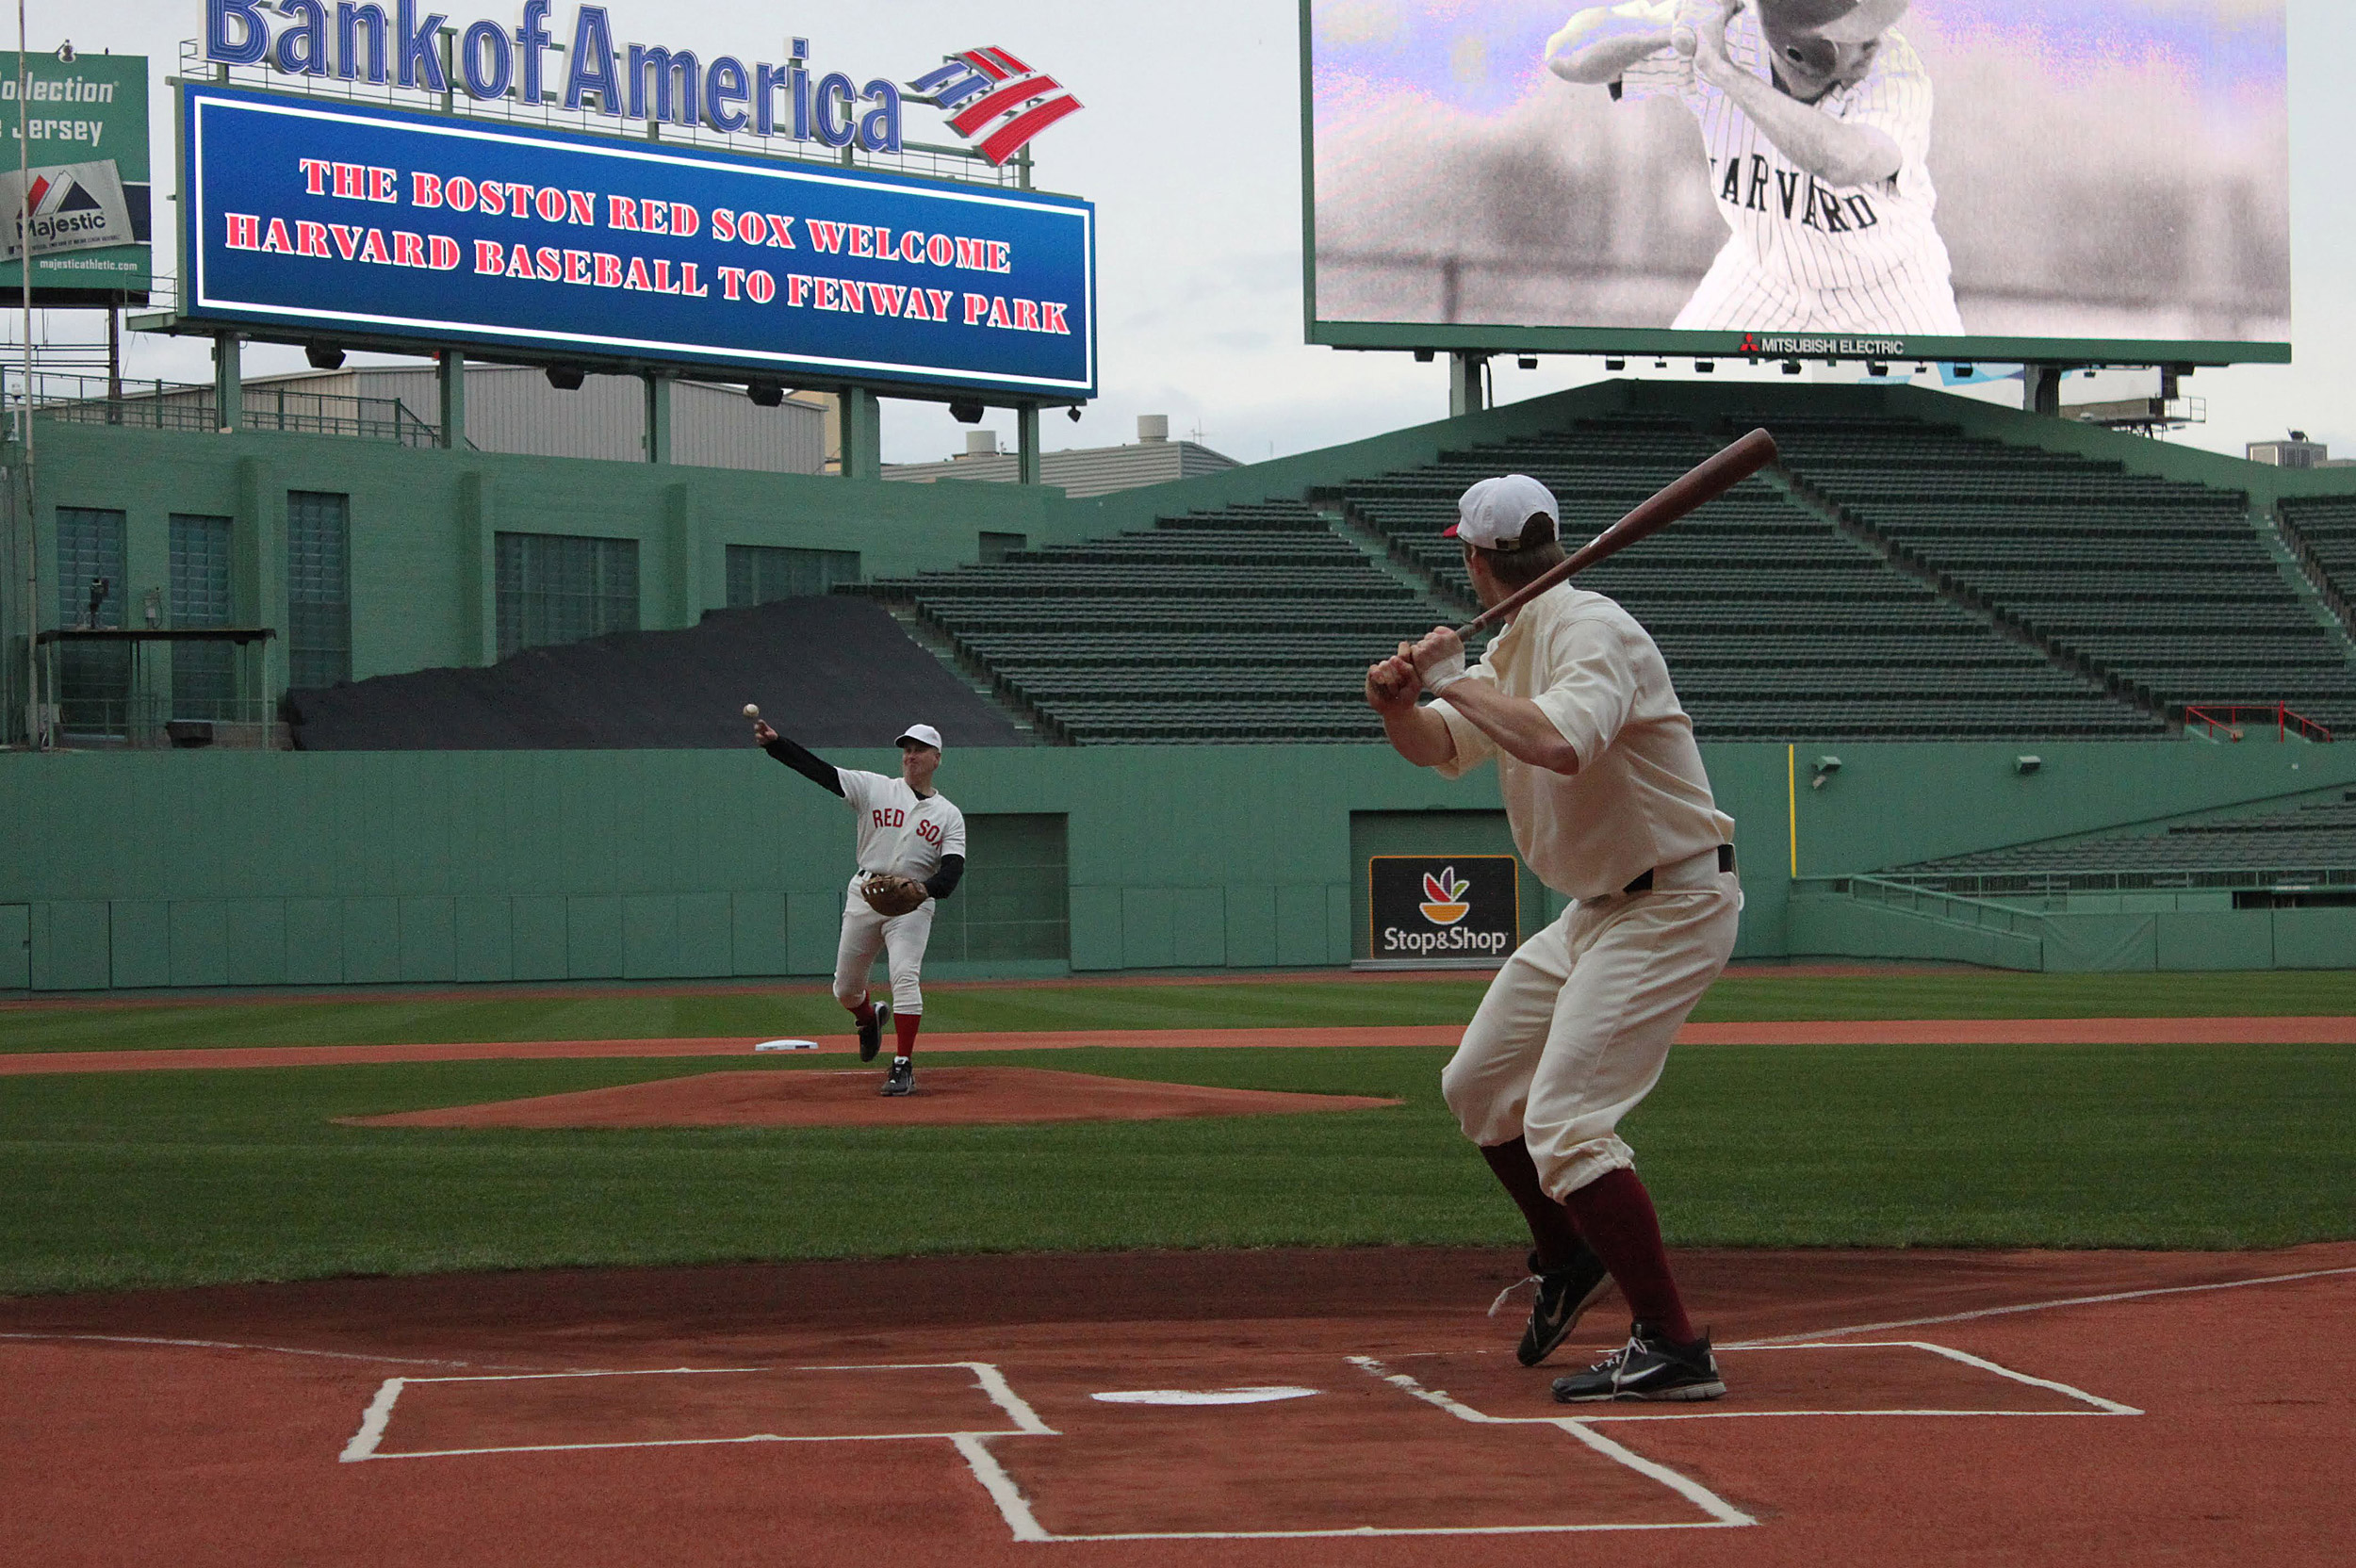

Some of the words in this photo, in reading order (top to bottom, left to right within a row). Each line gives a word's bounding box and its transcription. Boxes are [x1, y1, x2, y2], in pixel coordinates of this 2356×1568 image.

[0, 71, 113, 103] olection
[197, 0, 450, 93] Bank
[456, 0, 552, 106] of
[556, 3, 903, 155] America
[1710, 154, 1878, 233] ARVARD
[16, 212, 106, 241] Majestic
[299, 158, 398, 204] THE
[411, 172, 596, 226] BOSTON
[608, 194, 699, 237] RED
[712, 208, 795, 249] SOX
[805, 219, 1010, 274] WELCOME
[40, 259, 138, 270] majesticathletic.com
[224, 212, 461, 270] HARVARD
[474, 239, 708, 298] BASEBALL
[717, 266, 776, 304] TO
[787, 273, 953, 322] FENWAY
[963, 293, 1071, 335] PARK
[1761, 338, 1837, 353] MITSUBISHI
[1840, 340, 1904, 354] ELECTRIC
[873, 808, 905, 828] RED
[1384, 926, 1506, 955] Stop&Shop
